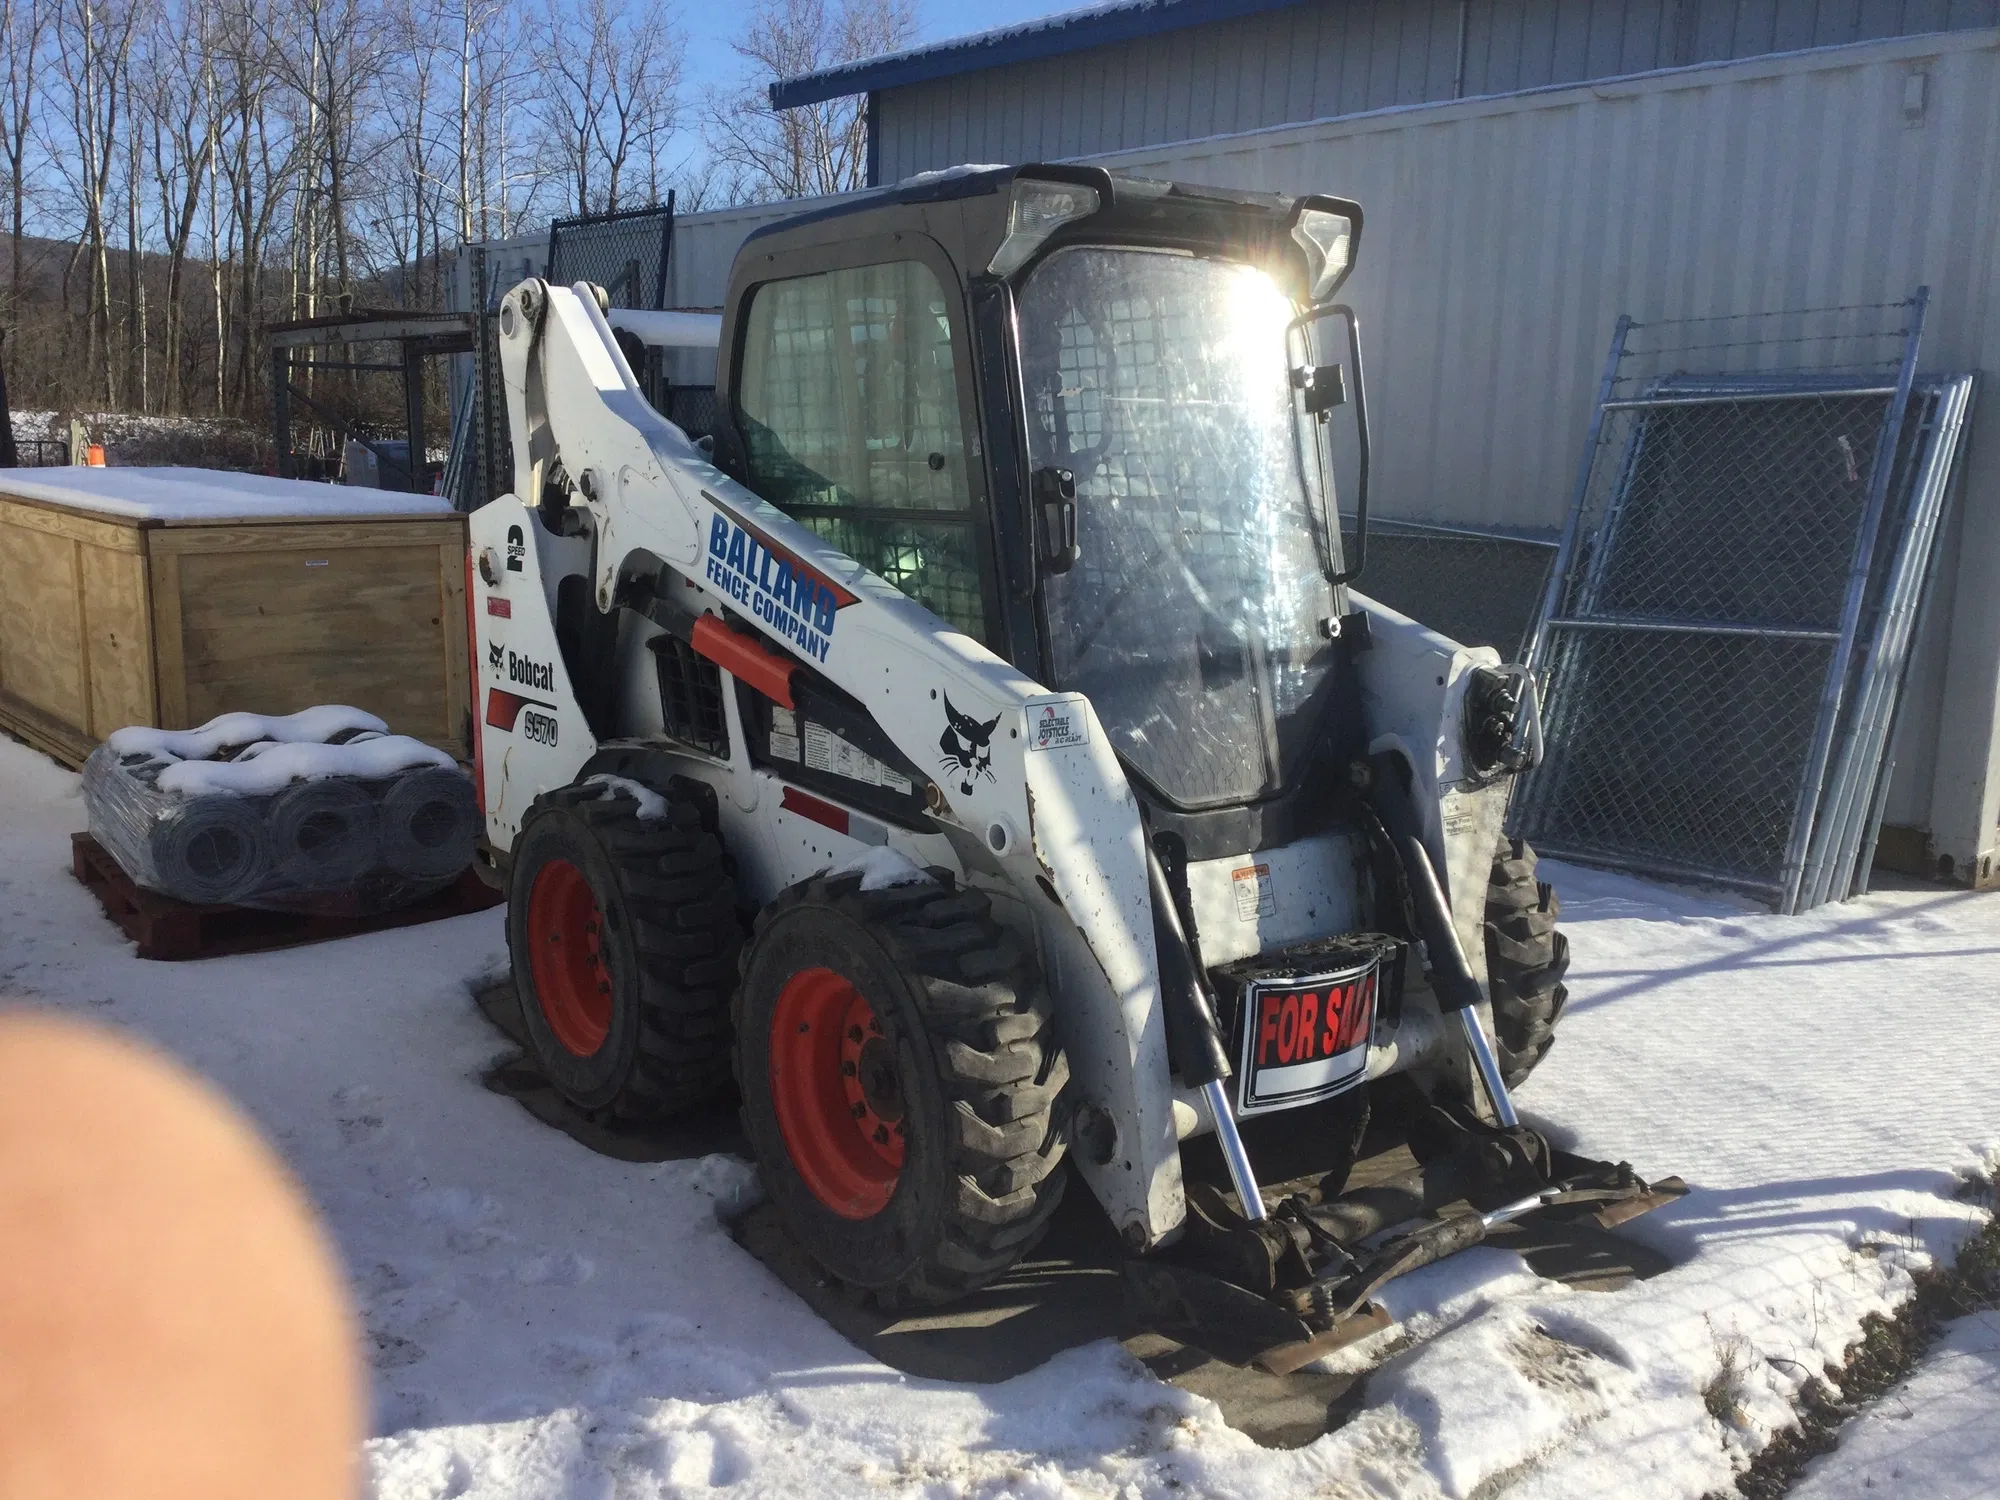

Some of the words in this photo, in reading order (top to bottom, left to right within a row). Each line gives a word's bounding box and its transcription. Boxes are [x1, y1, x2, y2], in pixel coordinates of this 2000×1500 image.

[507, 545, 526, 557] SPEED
[709, 512, 837, 637] BALLAND
[706, 556, 750, 607] FENCE
[752, 591, 831, 664] COMPANY
[509, 650, 554, 693] Bobcat
[524, 710, 558, 748] S570
[1038, 726, 1069, 740] JOYSTICKS
[1258, 992, 1319, 1065] FOR
